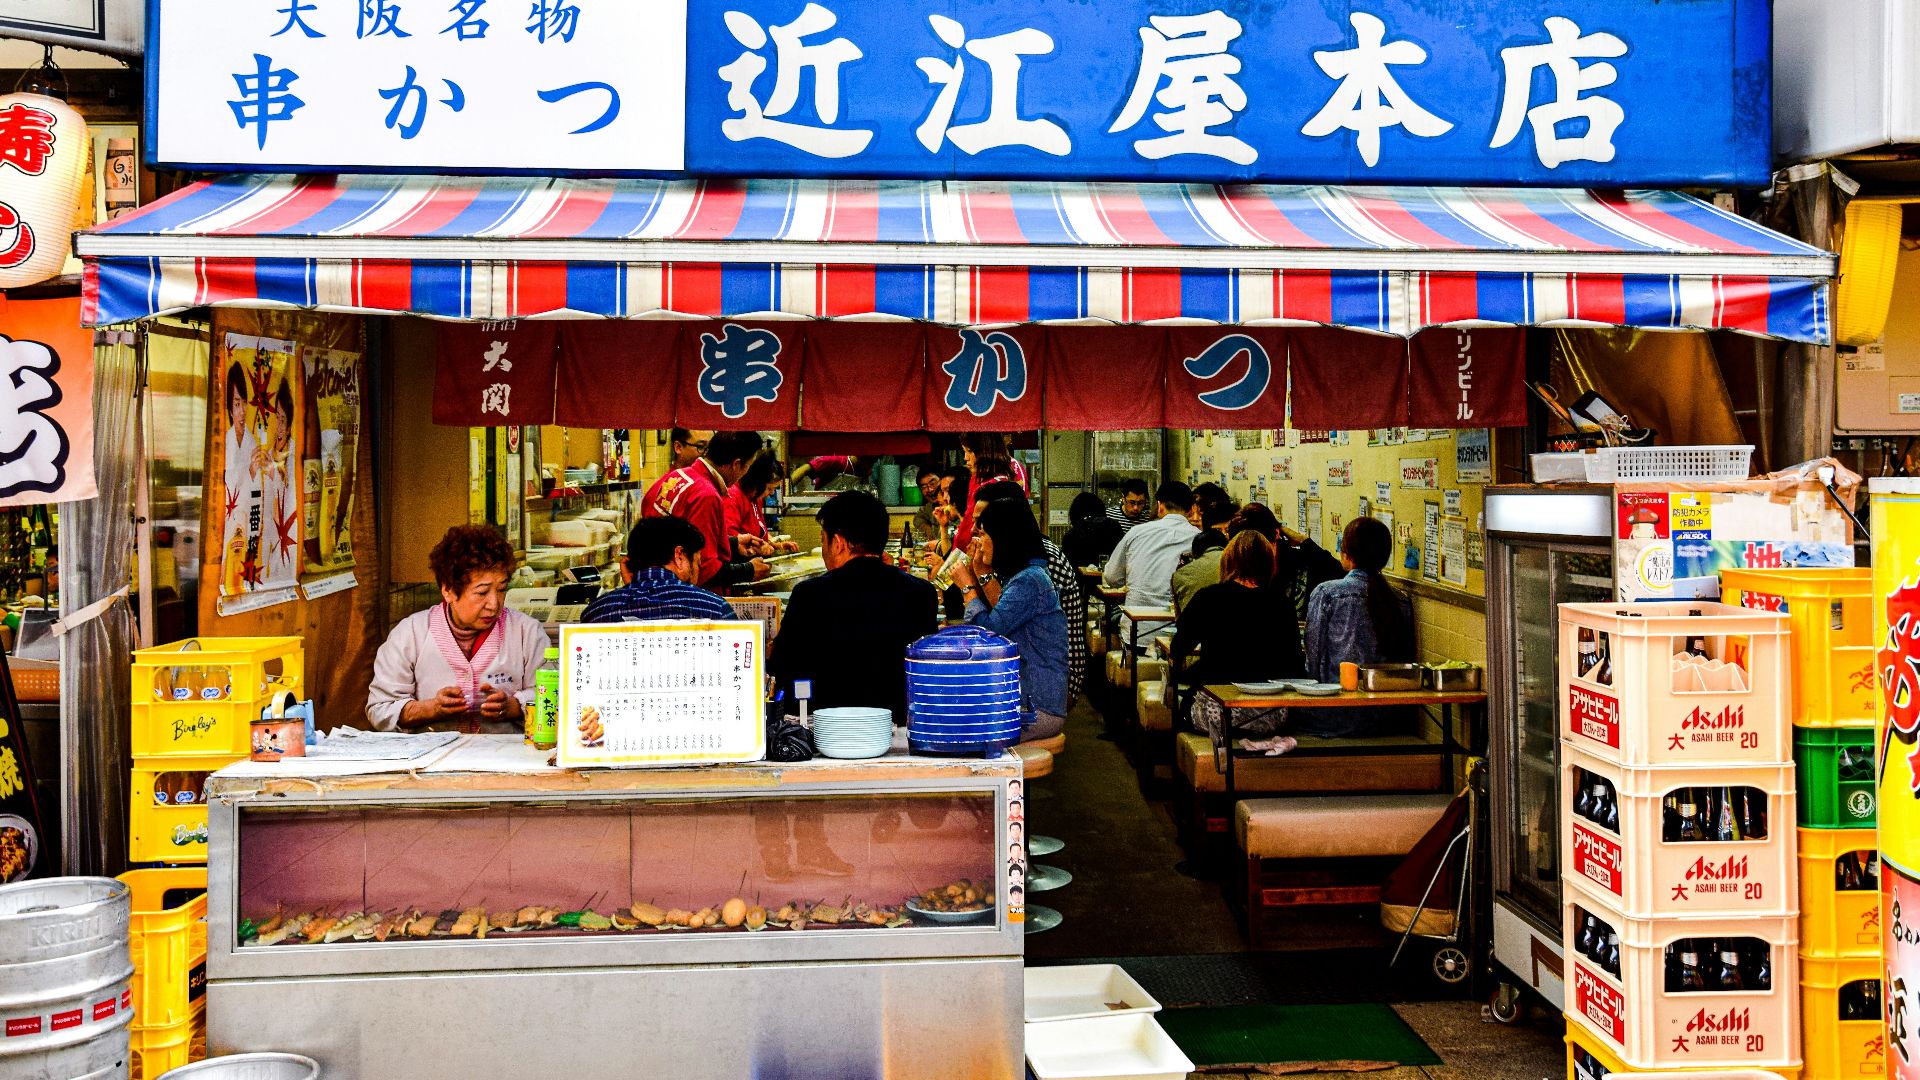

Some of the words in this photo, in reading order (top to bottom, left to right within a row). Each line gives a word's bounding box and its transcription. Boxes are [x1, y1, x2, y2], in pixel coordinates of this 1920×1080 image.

[270, 0, 580, 44] 大阪名物
[227, 53, 620, 151] 串かつ
[718, 2, 1628, 170] 近江屋本店
[481, 340, 513, 416] 大関
[698, 323, 1271, 418] 串かつ
[1456, 328, 1473, 421] リンビール
[1672, 508, 1710, 517] 防犯カメラ
[1679, 518, 1704, 527] 作動中
[1647, 567, 1673, 581] レストラ
[543, 697, 556, 728] お茶
[1570, 689, 1618, 725] アサヒビール
[1681, 704, 1743, 730] Asahi
[1668, 733, 1685, 751] 大
[1691, 732, 1713, 743] ASAHI
[1716, 732, 1734, 742] BEER
[1740, 731, 1758, 749] 20
[1573, 827, 1622, 873] アサヒビール
[1685, 854, 1748, 880] Asahi
[1671, 883, 1689, 901] 大
[1694, 883, 1717, 893] ASAHI
[1720, 883, 1738, 893] BEER
[1744, 882, 1763, 900] 20
[32, 914, 102, 948] KIRIN
[1575, 966, 1624, 1021] アサヒビール
[1686, 1007, 1749, 1033] Asahi
[1672, 1035, 1690, 1053] 大
[1695, 1035, 1718, 1045] ASAHI
[1721, 1035, 1740, 1045] BEER
[1746, 1034, 1764, 1052] 20
